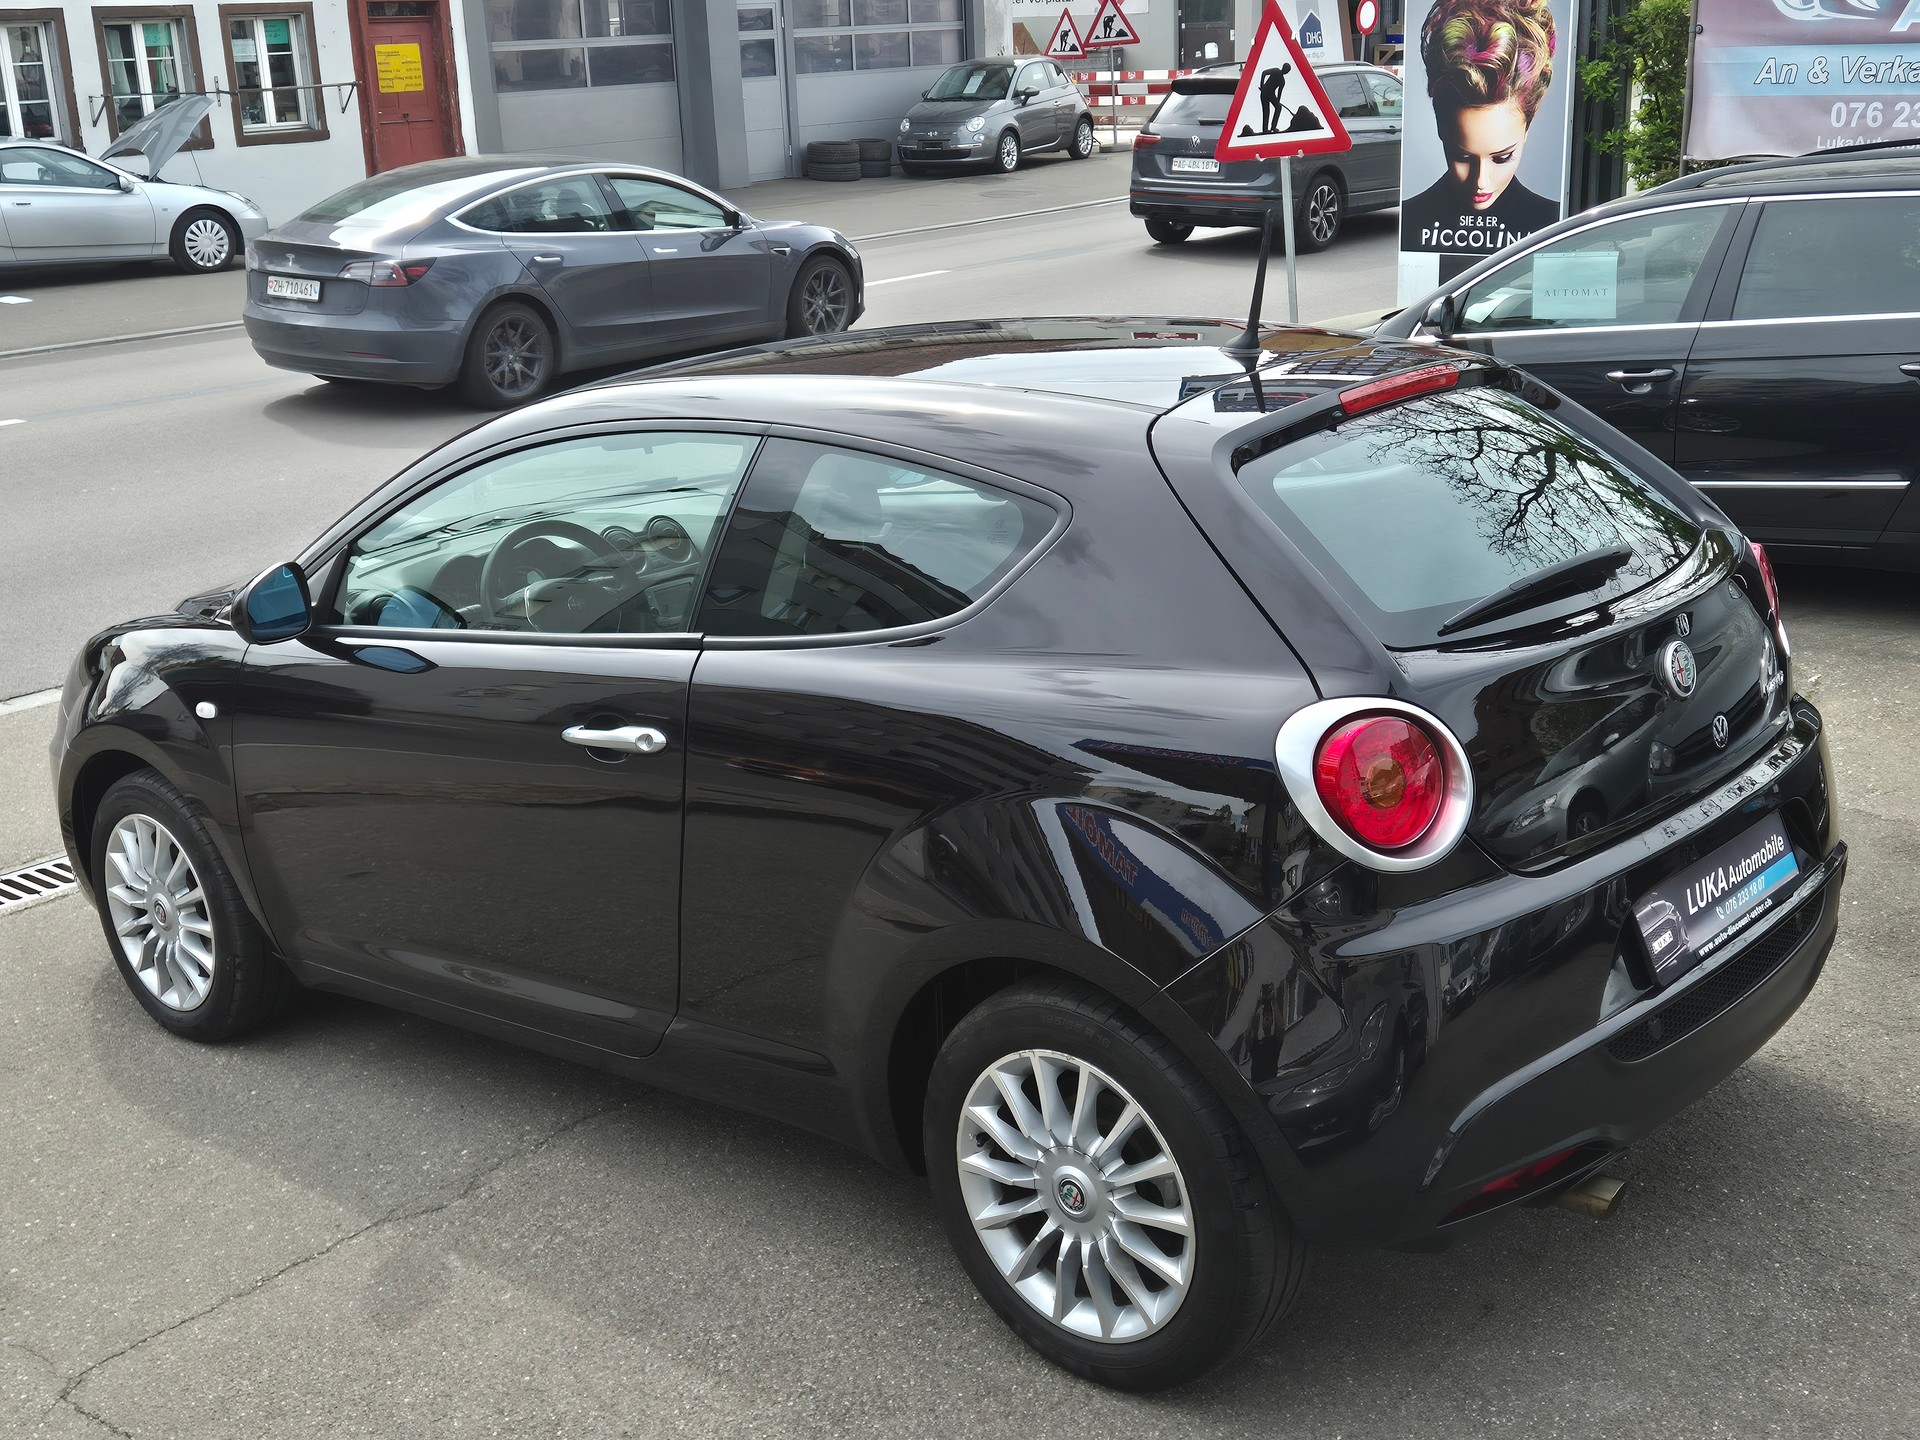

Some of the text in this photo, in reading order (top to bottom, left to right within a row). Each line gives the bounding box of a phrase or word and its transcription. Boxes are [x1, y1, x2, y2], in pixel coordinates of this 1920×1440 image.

[1306, 31, 1322, 44] DHG
[1754, 57, 1799, 84] An
[1807, 55, 1829, 84] &
[1830, 101, 1884, 128] 076
[1459, 215, 1498, 227] SIE & ER
[1544, 287, 1609, 297] AUTOMAT
[1686, 834, 1784, 916] LUKA Automobile
[1725, 875, 1766, 915] 076 233 18 07
[1698, 898, 1773, 957] www.auto-discount-uster.ch
